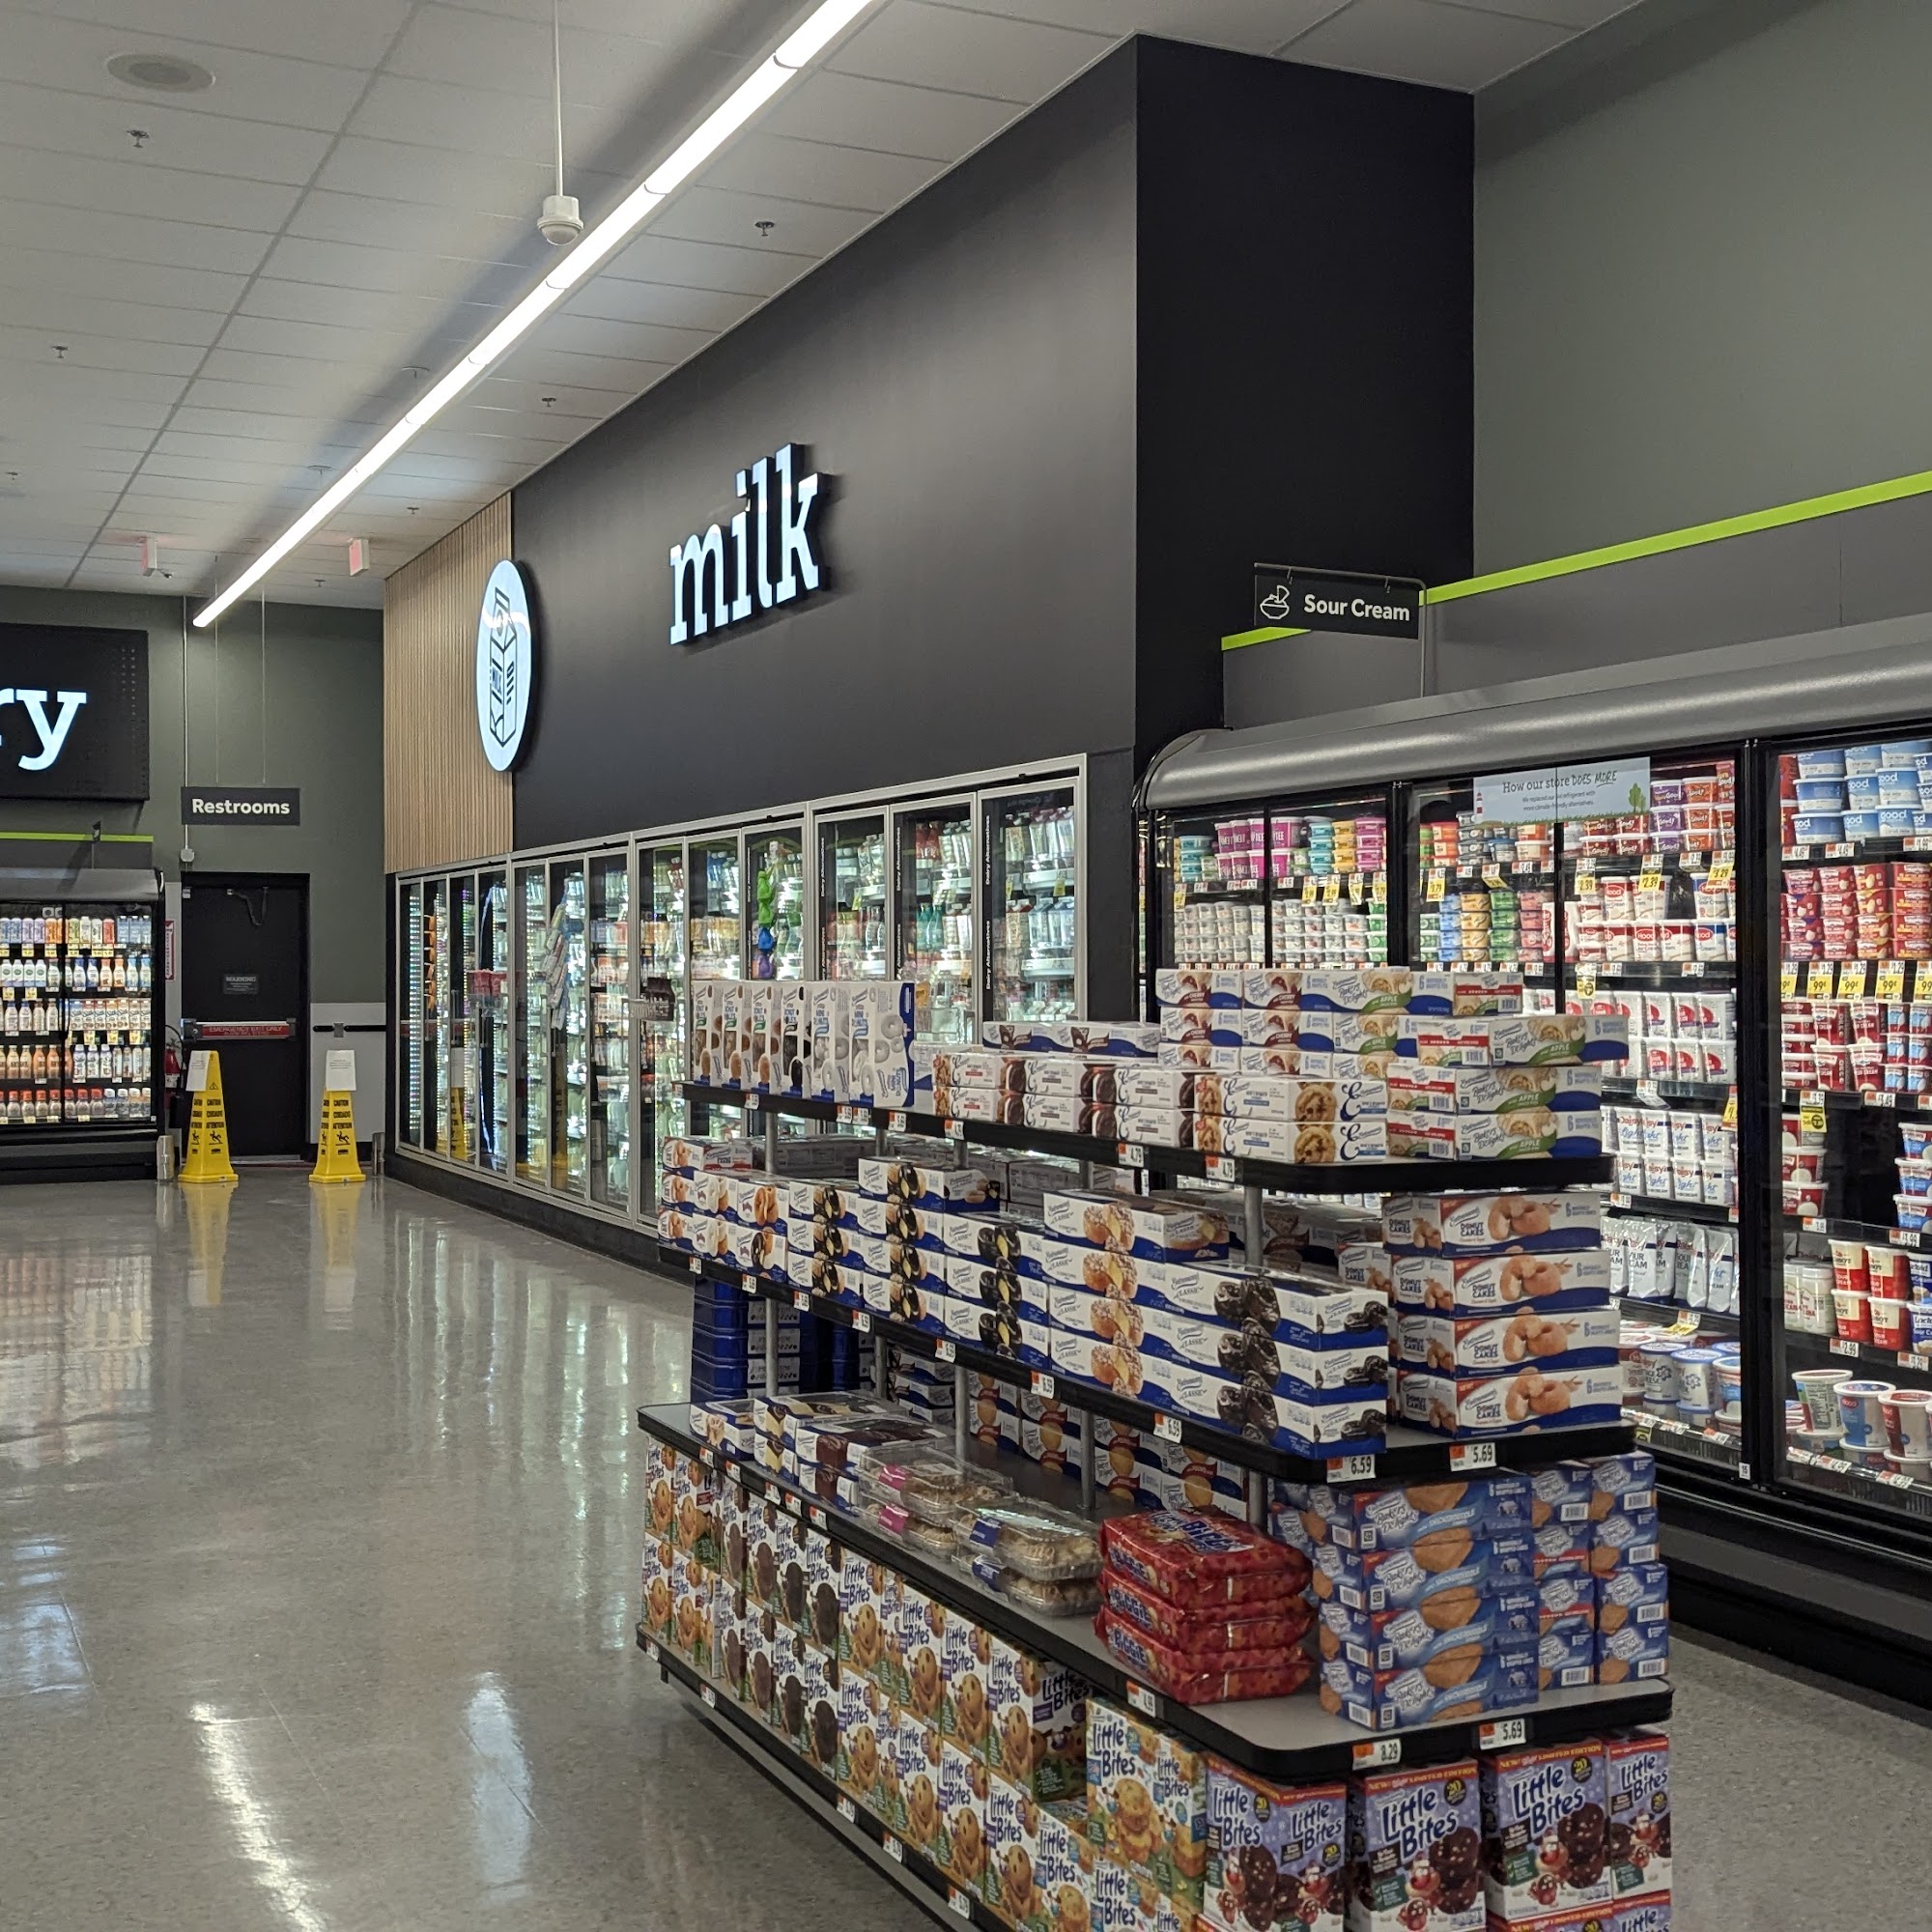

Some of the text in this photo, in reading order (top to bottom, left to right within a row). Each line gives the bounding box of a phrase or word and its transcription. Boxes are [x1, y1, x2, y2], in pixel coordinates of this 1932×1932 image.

[668, 443, 824, 645] milk
[1304, 594, 1409, 621] Sour Cream
[1502, 770, 1618, 793] How our store DOES MORE
[192, 798, 290, 814] Restrooms
[1880, 809, 1908, 822] good
[1635, 930, 1655, 939] Hood
[1279, 993, 1295, 1002] CHERRY
[1276, 1032, 1293, 1040] CHERRY
[1550, 1043, 1570, 1052] APPLE
[1520, 1139, 1540, 1148] APPLE
[1461, 1228, 1484, 1236] CAKES
[1474, 1344, 1498, 1352] DONUT
[1476, 1404, 1500, 1412] DONUT
[1476, 1410, 1500, 1419] CAKES
[806, 1540, 823, 1565] Little
[810, 1561, 829, 1582] Bites
[843, 1561, 866, 1589] Little
[849, 1584, 869, 1605] Bites
[903, 1602, 923, 1630] Little
[908, 1623, 929, 1646] Bites
[946, 1626, 967, 1656] Little
[952, 1651, 975, 1673] Bites
[991, 1653, 1012, 1683] Little
[841, 1683, 862, 1709] Little
[998, 1680, 1020, 1704] Bites
[847, 1703, 868, 1724] Bites
[899, 1726, 918, 1755] Little
[1092, 1723, 1123, 1755] Little
[904, 1750, 926, 1774] Bites
[942, 1758, 963, 1787] Little
[1101, 1749, 1135, 1776] Bites
[1574, 1758, 1588, 1769] 20
[1621, 1755, 1656, 1790] Little
[949, 1783, 971, 1805] Bites
[1512, 1766, 1565, 1818] Little
[1634, 1770, 1667, 1801] Bites
[990, 1792, 1014, 1823] Little
[1212, 1786, 1248, 1823] Little
[1382, 1787, 1437, 1842] Little
[1532, 1788, 1583, 1833] Bites
[997, 1818, 1022, 1842] Bites
[1222, 1816, 1262, 1846] Bites
[1291, 1803, 1329, 1837] Little
[1039, 1830, 1065, 1861] Little
[1304, 1821, 1343, 1851] Bites
[1402, 1811, 1457, 1859] Bites
[1046, 1857, 1075, 1882] Bites
[1095, 1869, 1125, 1901] Little
[1104, 1898, 1135, 1925] Bites
